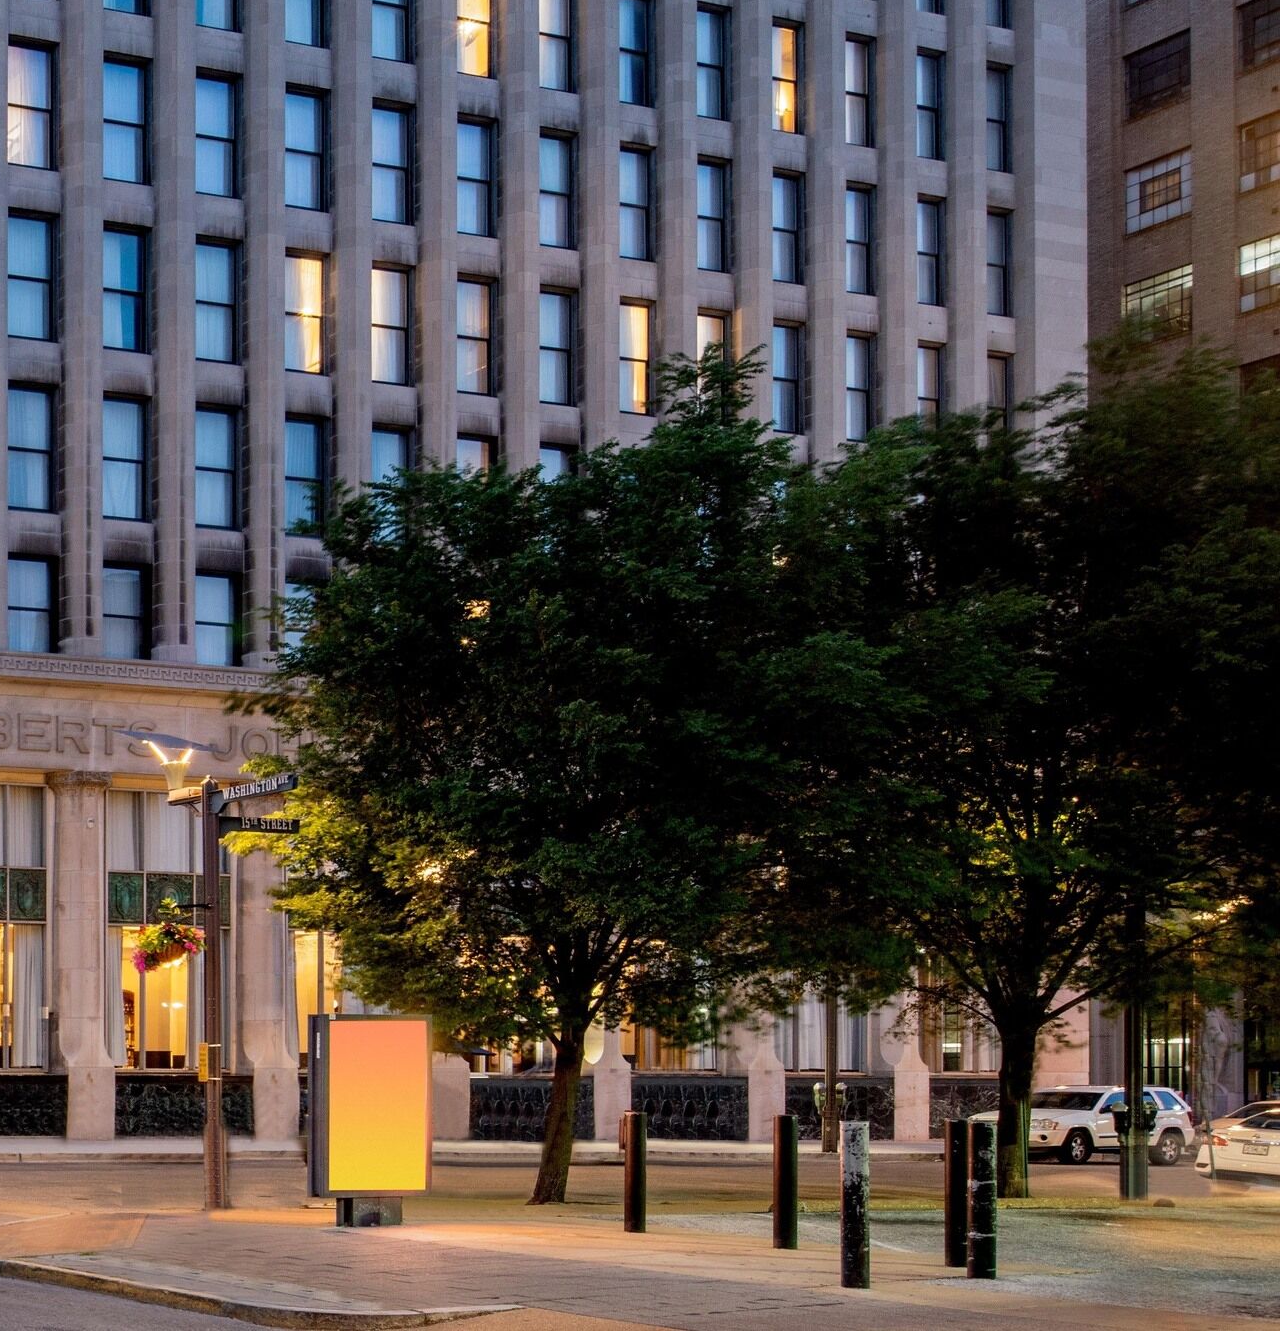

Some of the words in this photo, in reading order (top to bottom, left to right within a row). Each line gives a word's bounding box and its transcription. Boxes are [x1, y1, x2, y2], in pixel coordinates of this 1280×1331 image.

[222, 777, 278, 800] WASHINGTON
[278, 775, 289, 785] AVE
[260, 818, 293, 830] STREET
